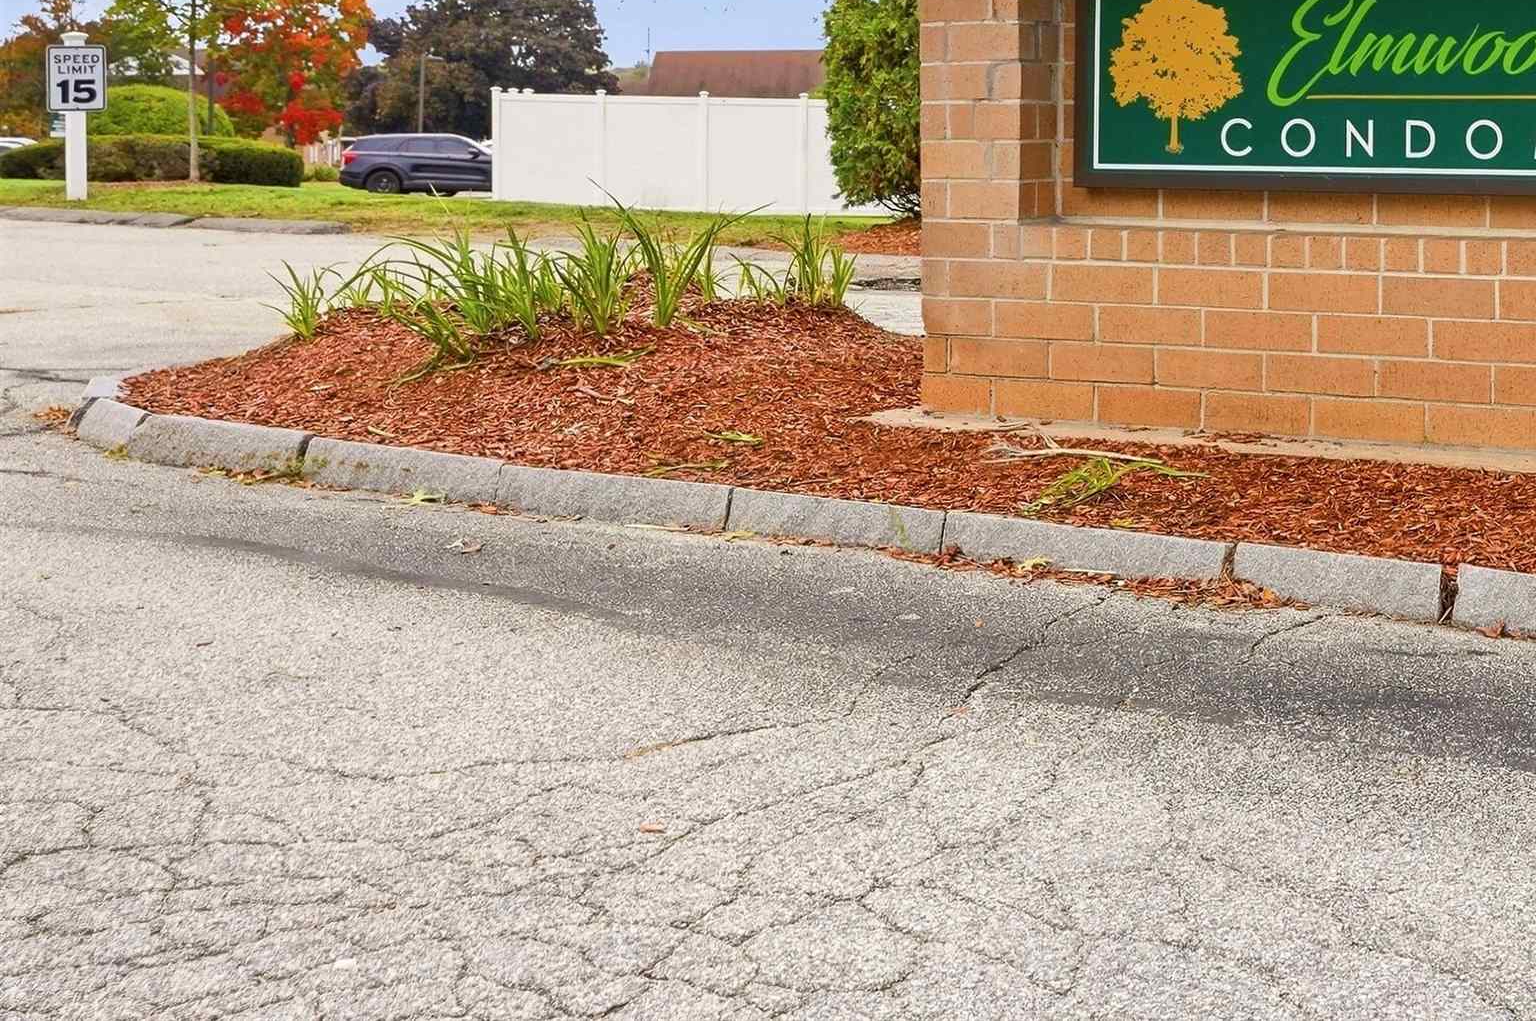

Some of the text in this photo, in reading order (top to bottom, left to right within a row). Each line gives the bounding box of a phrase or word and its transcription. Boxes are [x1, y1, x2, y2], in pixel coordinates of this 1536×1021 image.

[53, 54, 100, 64] SPEED
[57, 65, 96, 75] LIMIT
[56, 79, 97, 104] 15
